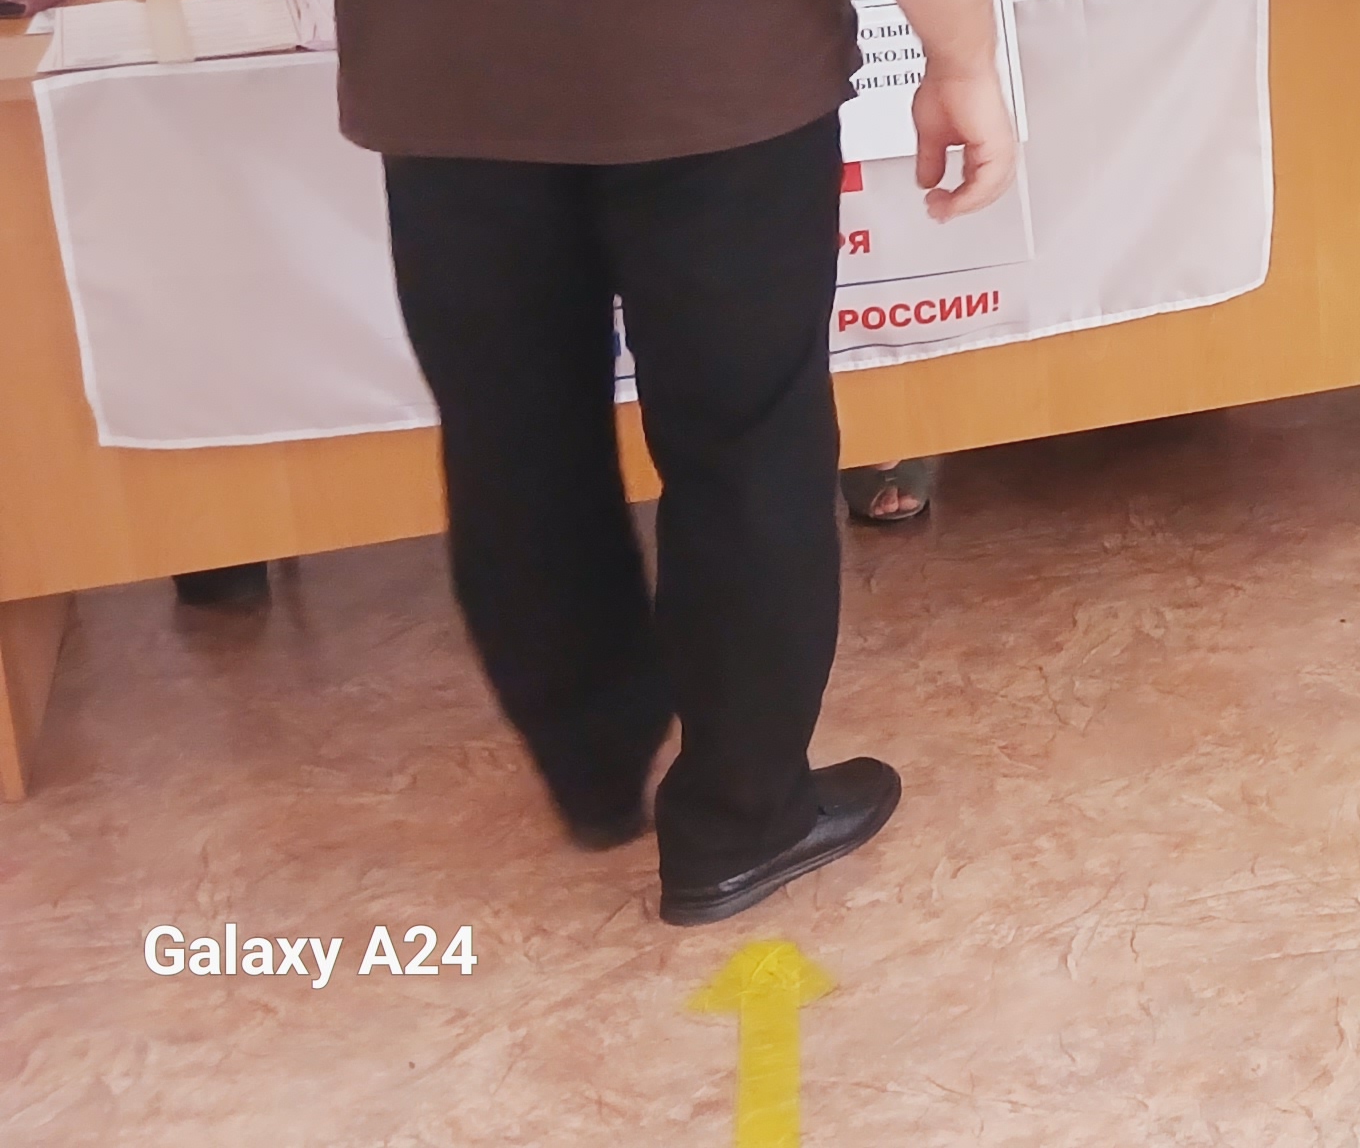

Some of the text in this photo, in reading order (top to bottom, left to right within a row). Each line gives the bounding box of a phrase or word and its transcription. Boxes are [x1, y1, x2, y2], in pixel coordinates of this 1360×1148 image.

[860, 23, 911, 41] ОЛЬН
[866, 48, 921, 64] КОЛЬ
[856, 69, 921, 91] БИЛЕЙ
[837, 289, 1000, 333] РОССИИ!
